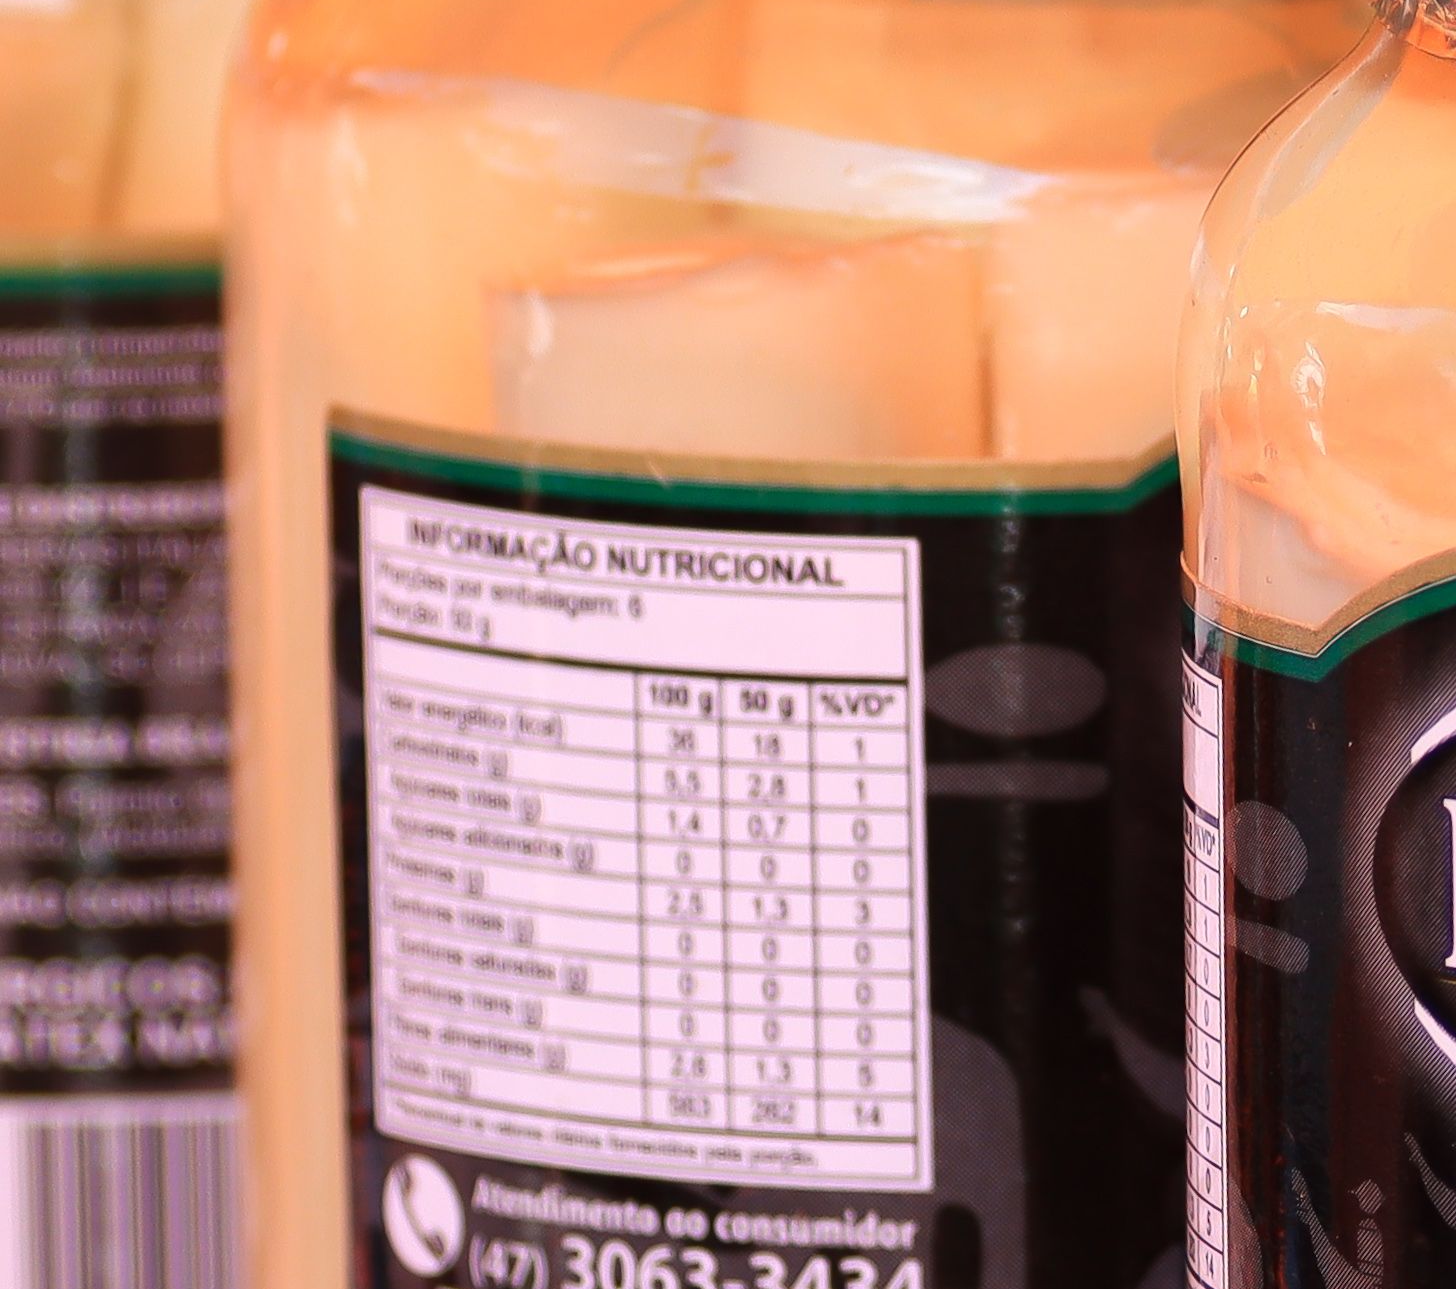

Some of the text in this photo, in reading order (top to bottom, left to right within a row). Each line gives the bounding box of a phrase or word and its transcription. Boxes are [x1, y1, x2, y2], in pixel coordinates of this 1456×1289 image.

[408, 516, 844, 588] INFORMAÇÃO NUTRICIONAL
[650, 683, 689, 708] 100
[740, 688, 768, 713] 50
[471, 1175, 918, 1251] Atendimento ao consumidor
